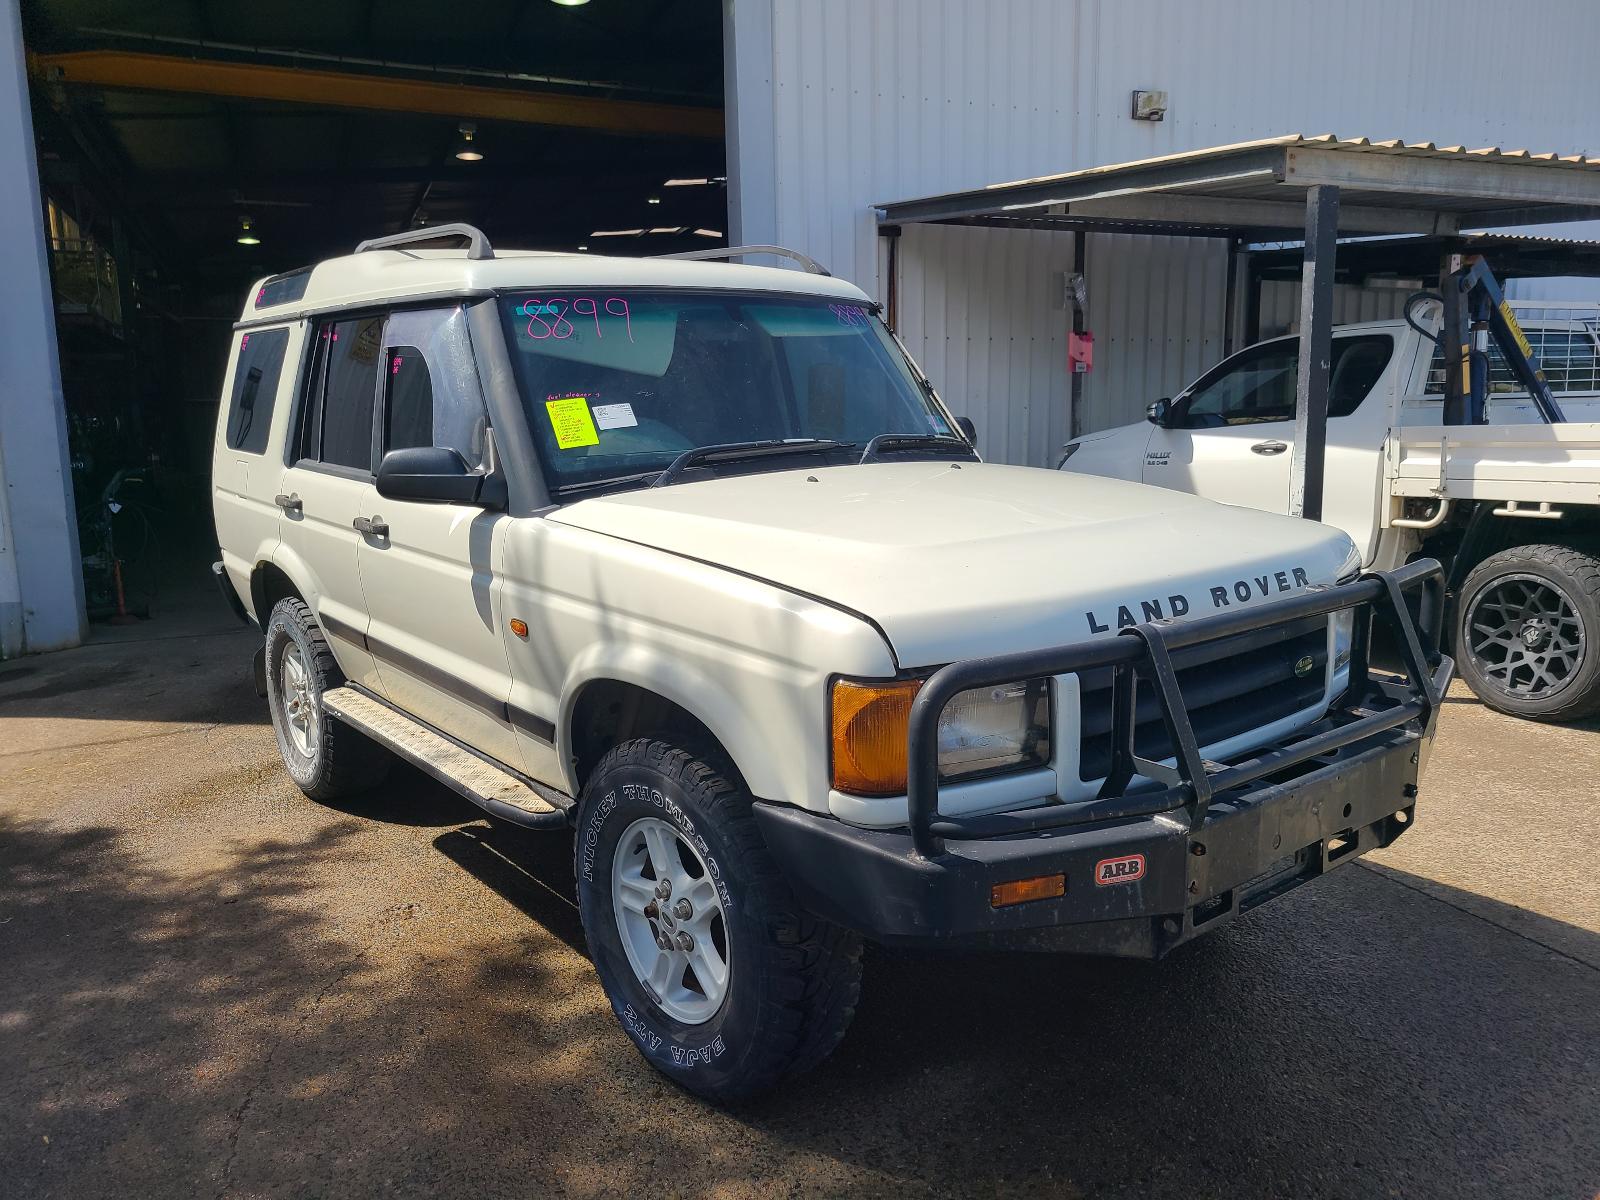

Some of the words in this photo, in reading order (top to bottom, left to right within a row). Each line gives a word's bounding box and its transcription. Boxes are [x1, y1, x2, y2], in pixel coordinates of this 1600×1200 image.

[523, 298, 634, 344] 8899
[1085, 594, 1189, 634] LAND
[1209, 567, 1310, 608] ROVER
[583, 791, 617, 882] MICKEY
[622, 784, 733, 908] THOMPSON
[1101, 860, 1140, 879] ARB
[670, 1034, 726, 1067] BAJA
